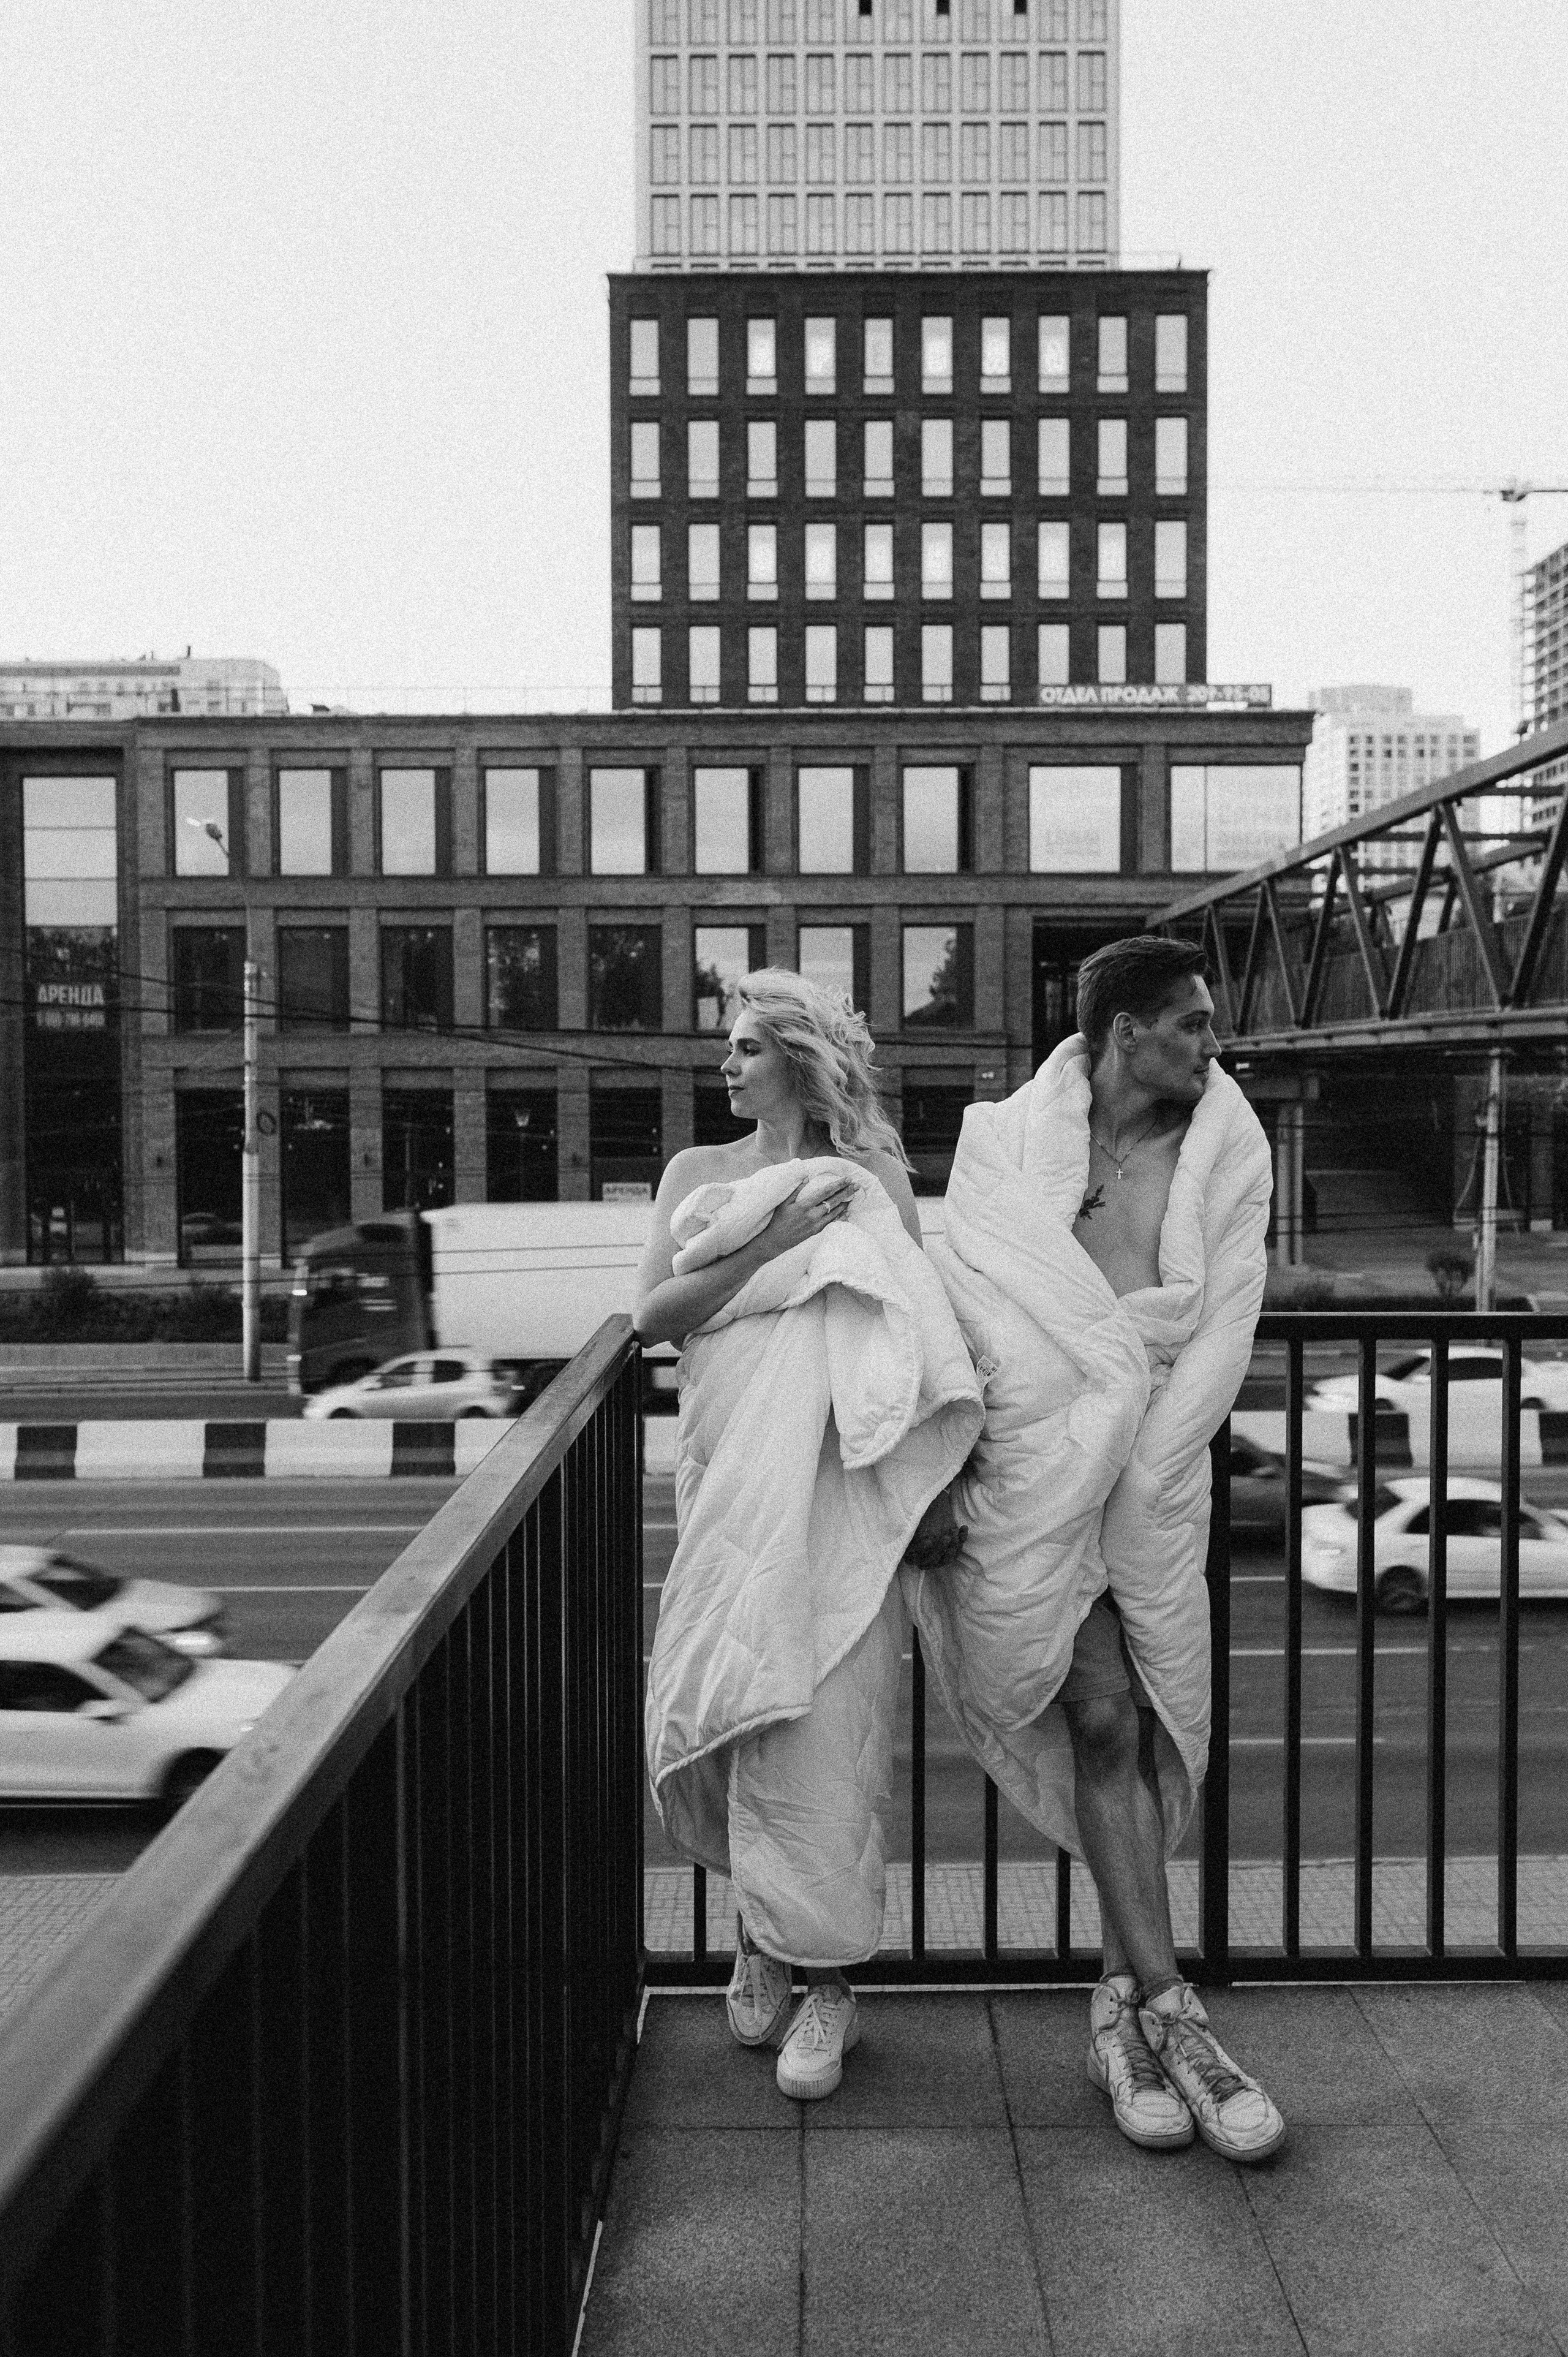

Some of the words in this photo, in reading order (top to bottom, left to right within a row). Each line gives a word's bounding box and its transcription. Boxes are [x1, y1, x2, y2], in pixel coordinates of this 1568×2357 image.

[1040, 685, 1098, 704] ОТДЕЛ
[1100, 685, 1180, 704] ПРОДАЖ
[37, 984, 105, 1005] АРЕНДА
